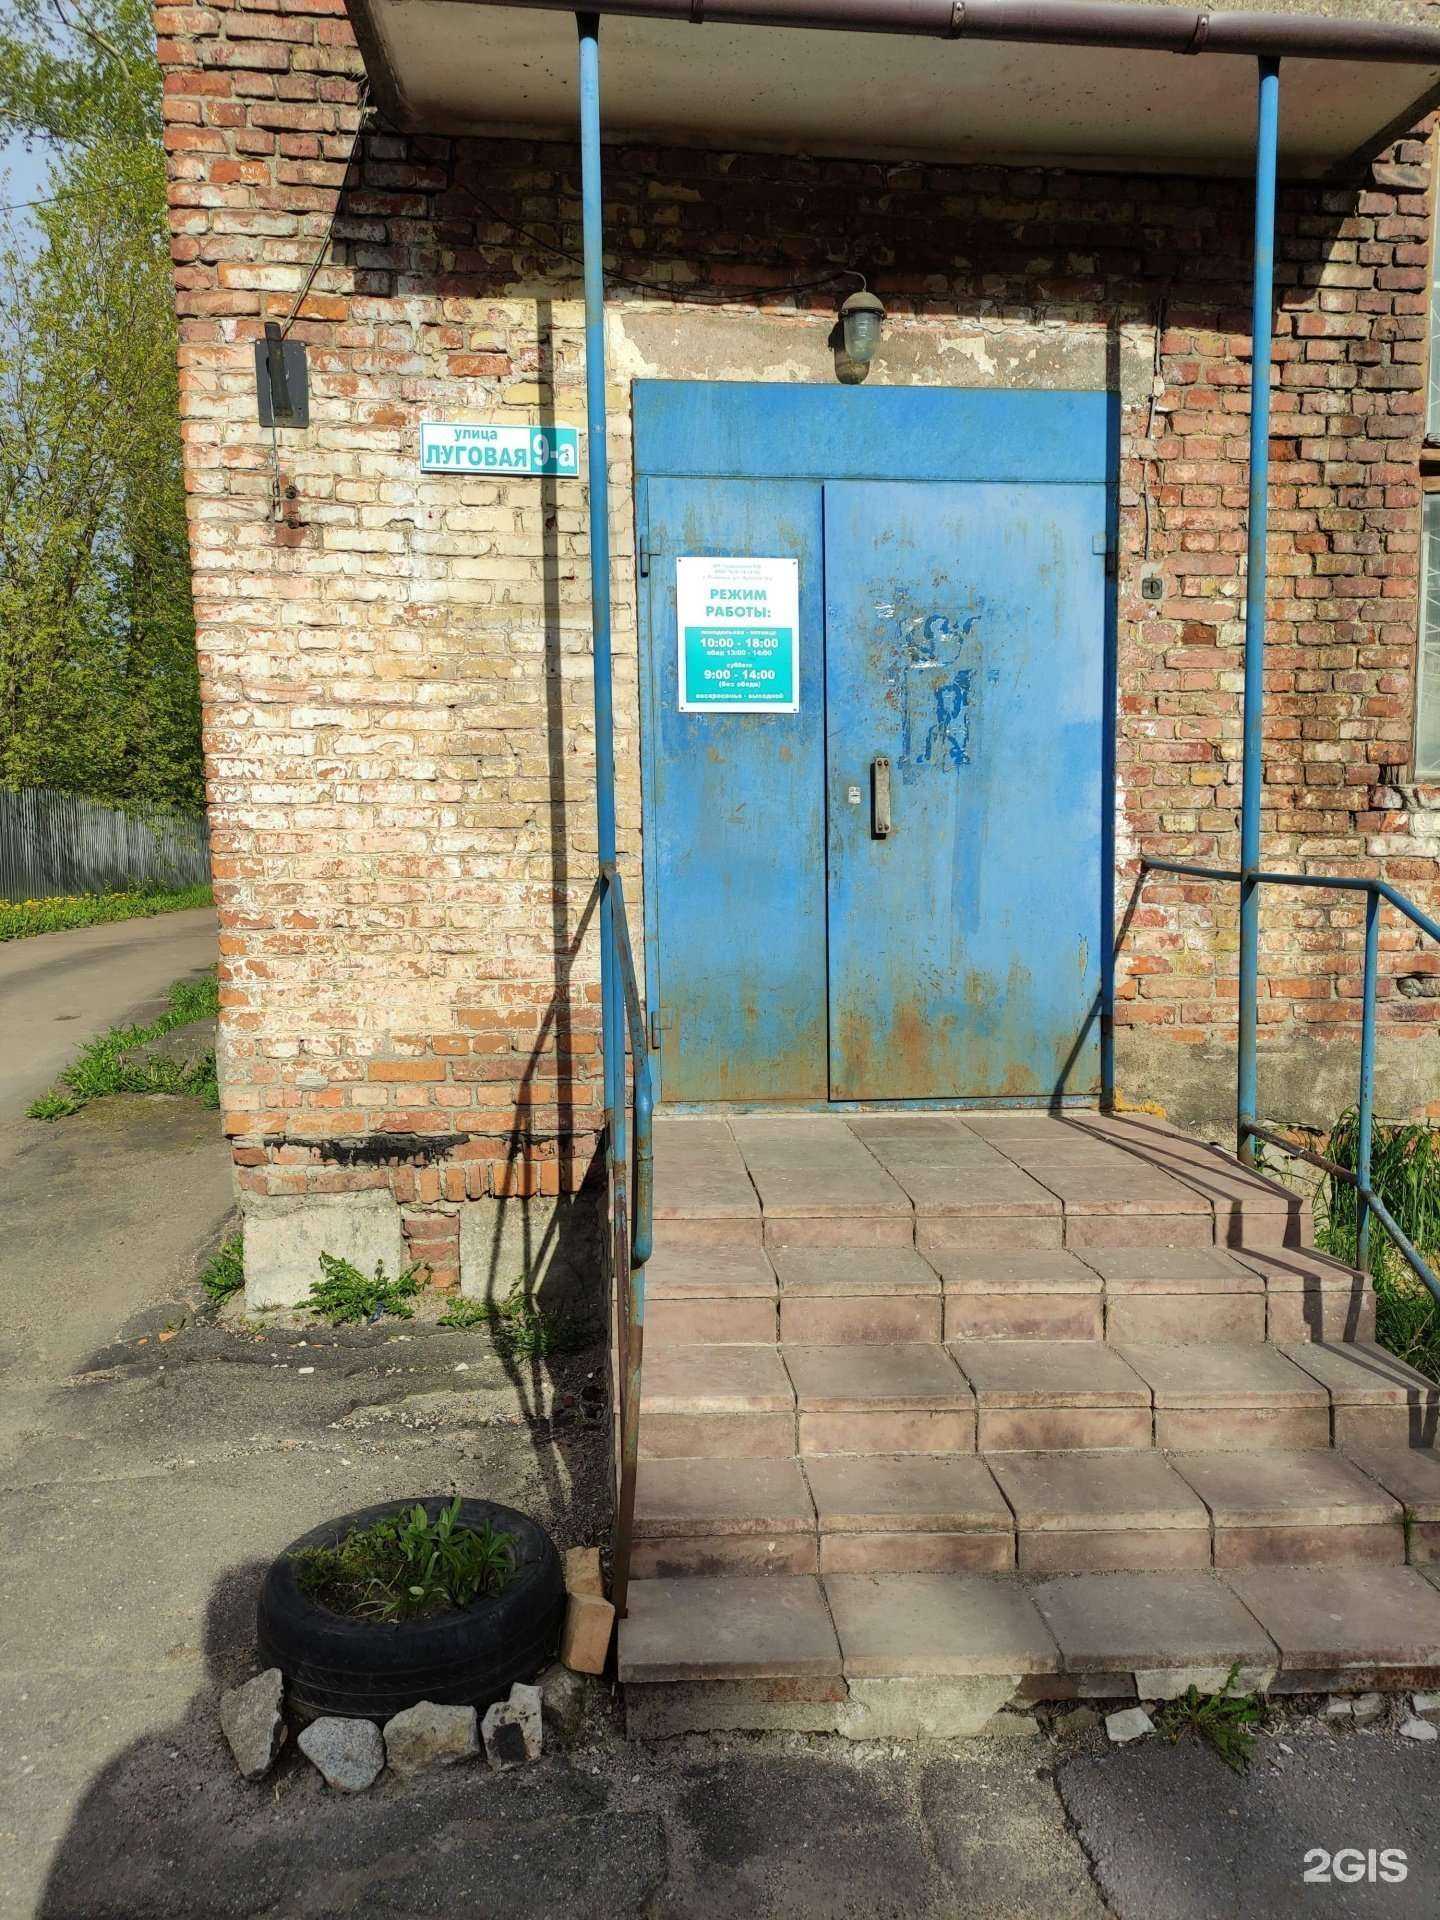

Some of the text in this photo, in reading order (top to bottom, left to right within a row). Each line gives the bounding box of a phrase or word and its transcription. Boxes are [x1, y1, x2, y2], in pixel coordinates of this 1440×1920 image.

[454, 428, 498, 442] улица
[425, 444, 527, 467] ЛУГОВАЯ
[532, 433, 576, 467] 9-а
[710, 589, 767, 600] РЕЖИМ
[706, 606, 771, 618] РАБОТЫ:
[700, 638, 734, 648] 10:00
[745, 638, 779, 648] 18:00
[704, 669, 731, 679] 9:00
[742, 669, 776, 679] 14:00
